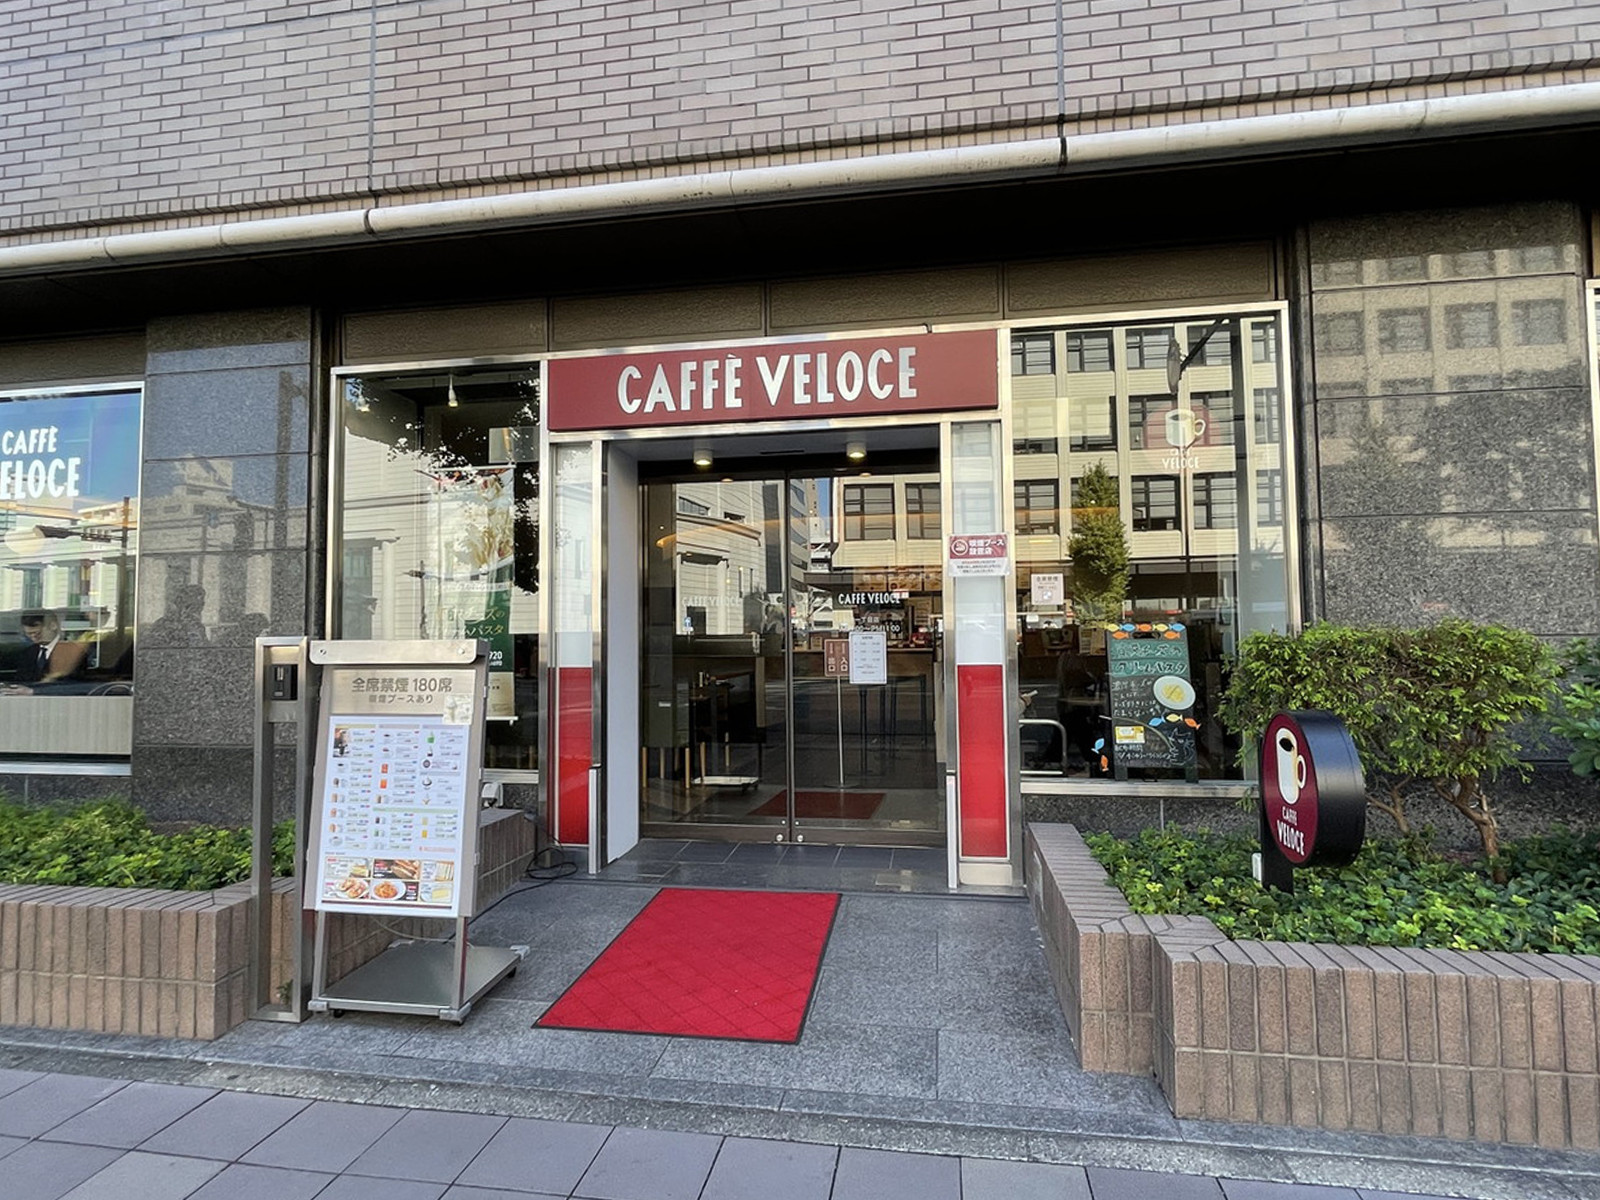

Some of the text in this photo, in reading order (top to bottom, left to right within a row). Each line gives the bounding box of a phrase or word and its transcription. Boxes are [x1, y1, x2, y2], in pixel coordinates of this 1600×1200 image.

[618, 346, 918, 414] CAFFÈ VELOCE
[1162, 456, 1199, 470] VELOCE
[867, 592, 900, 604] VELOCE
[352, 677, 453, 693] 全席禁煙 180席
[1276, 819, 1305, 856] VELOCE
